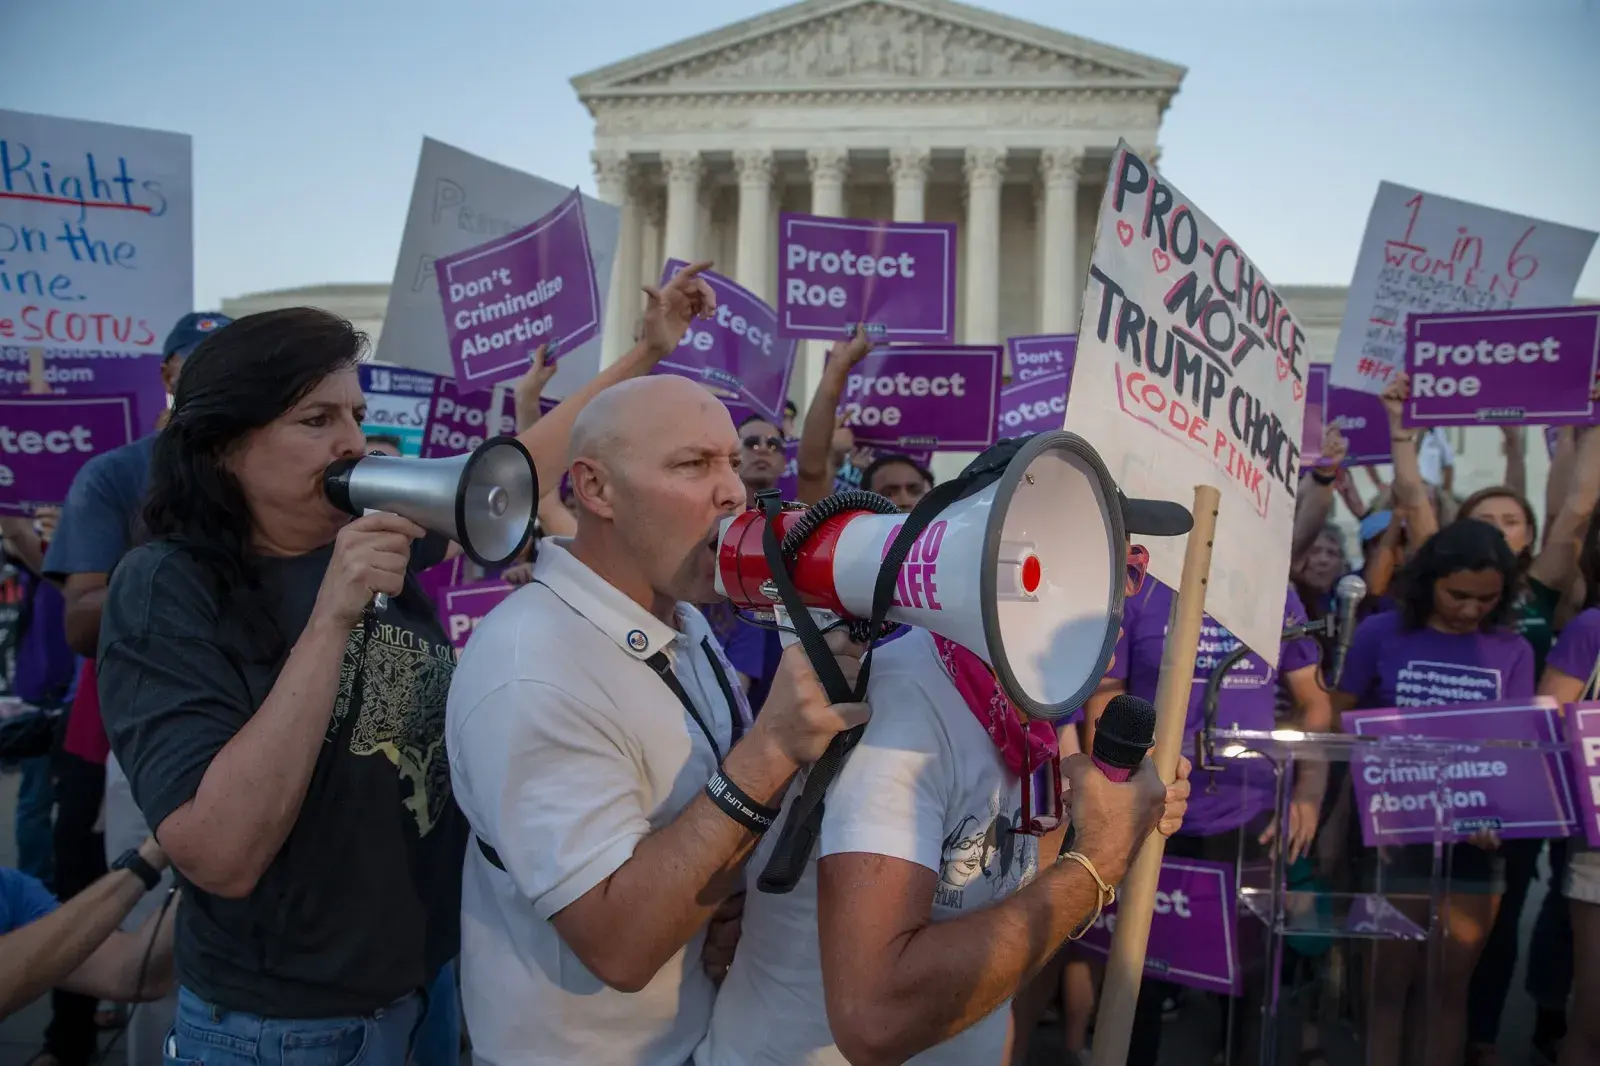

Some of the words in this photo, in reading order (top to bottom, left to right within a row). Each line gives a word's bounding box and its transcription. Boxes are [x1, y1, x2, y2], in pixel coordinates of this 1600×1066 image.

[0, 140, 167, 222] Rights
[56, 223, 138, 269] the
[787, 243, 916, 279] Protect
[1112, 149, 1306, 381] PRO-CHOICE
[1450, 226, 1483, 269] in
[1507, 224, 1540, 281] 6
[449, 266, 513, 303] Don't
[787, 277, 848, 308] Roe
[1384, 246, 1519, 299] WOMEN
[454, 276, 564, 331] Criminalize
[1163, 270, 1266, 369] NOT
[461, 313, 553, 360] Abortion
[716, 303, 773, 356] tect
[1413, 336, 1561, 367] Protect
[0, 365, 94, 383] redom
[846, 371, 967, 398] Protect
[1090, 263, 1226, 421] TRUMP
[1228, 385, 1300, 499] CHOICE
[1412, 372, 1482, 397] Roe
[845, 402, 903, 427] Roe
[1126, 372, 1209, 447] CODE
[1213, 428, 1266, 495] PINK
[890, 563, 943, 611] IFE
[1396, 681, 1488, 701] Pro-Justice.
[1397, 668, 1497, 689] Pro-Freedom.
[723, 791, 743, 810] LIFE
